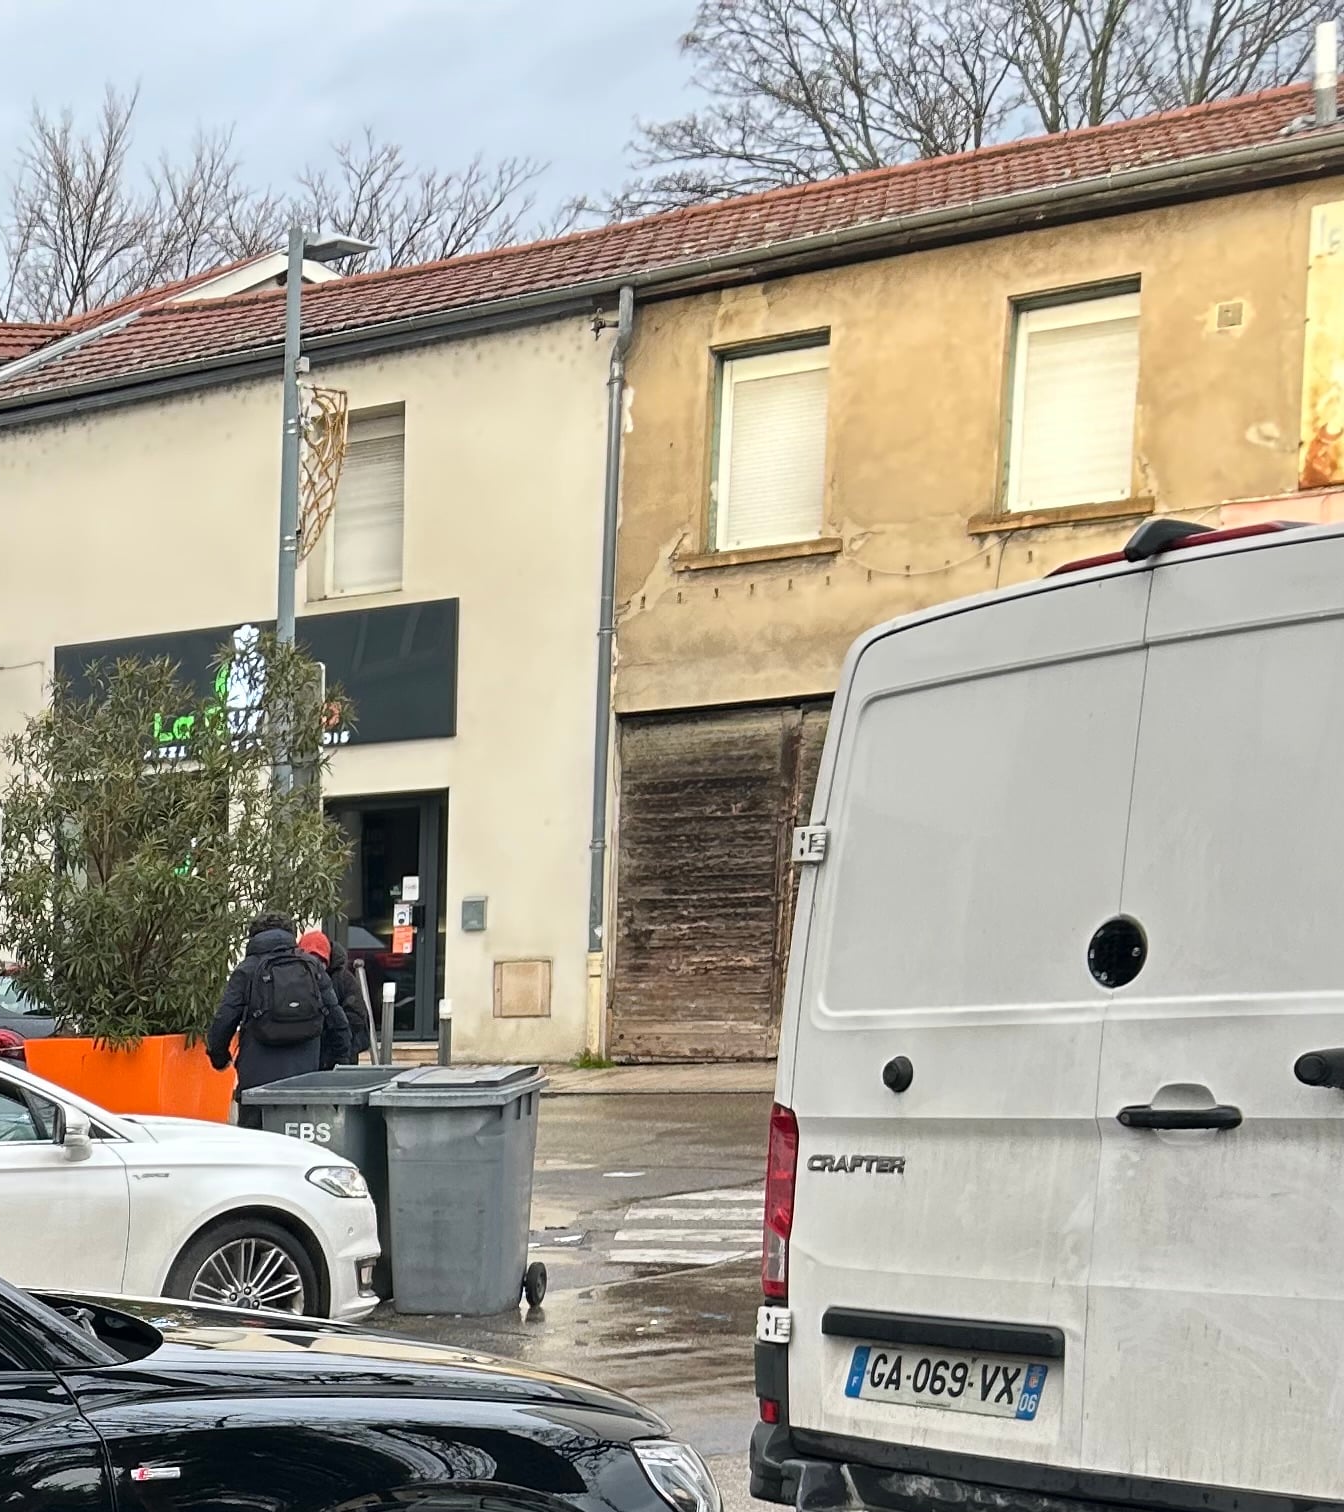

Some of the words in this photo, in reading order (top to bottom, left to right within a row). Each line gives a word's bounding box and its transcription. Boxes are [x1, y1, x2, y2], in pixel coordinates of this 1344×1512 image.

[153, 712, 195, 742] La
[807, 1154, 906, 1175] CRAFTER
[851, 1375, 859, 1388] F
[869, 1353, 1021, 1405] GA-069-VX
[1017, 1393, 1038, 1413] 06
